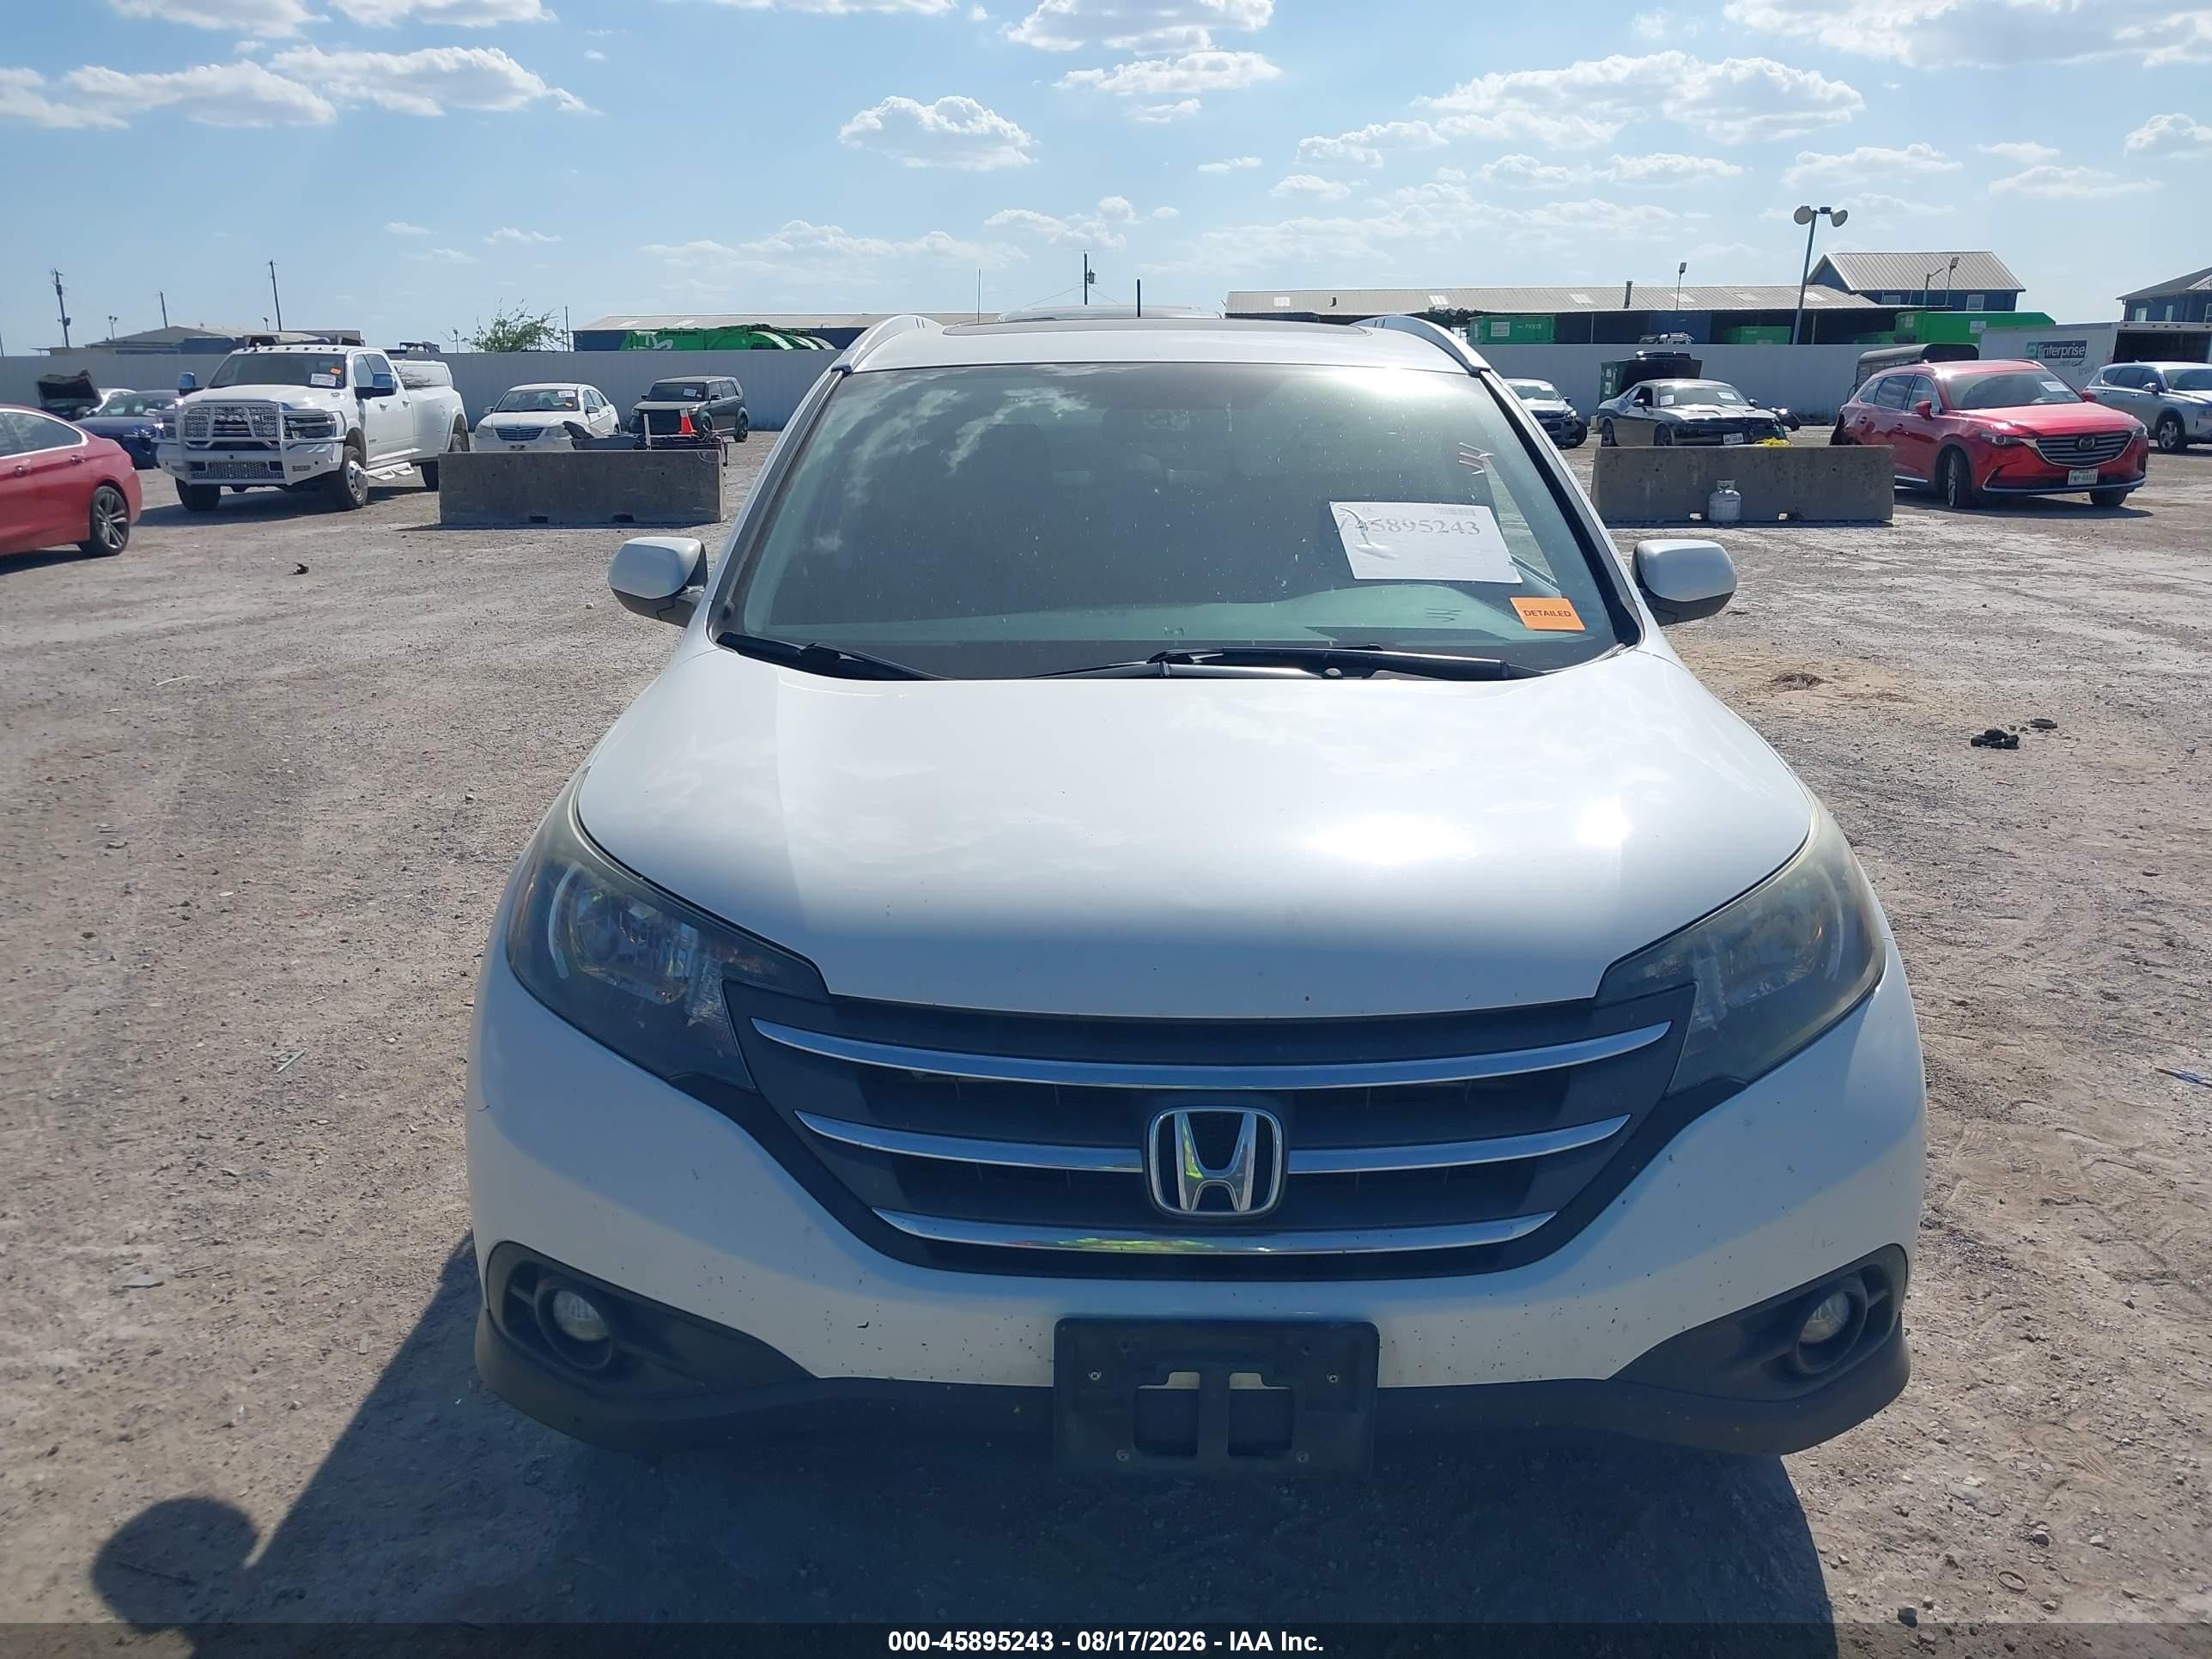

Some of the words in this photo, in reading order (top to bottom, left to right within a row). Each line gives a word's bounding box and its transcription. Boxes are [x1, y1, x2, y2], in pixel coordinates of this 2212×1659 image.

[2039, 344, 2085, 359] Enterprise
[1355, 518, 1480, 536] 45895243
[1522, 610, 1572, 618] DETAILED
